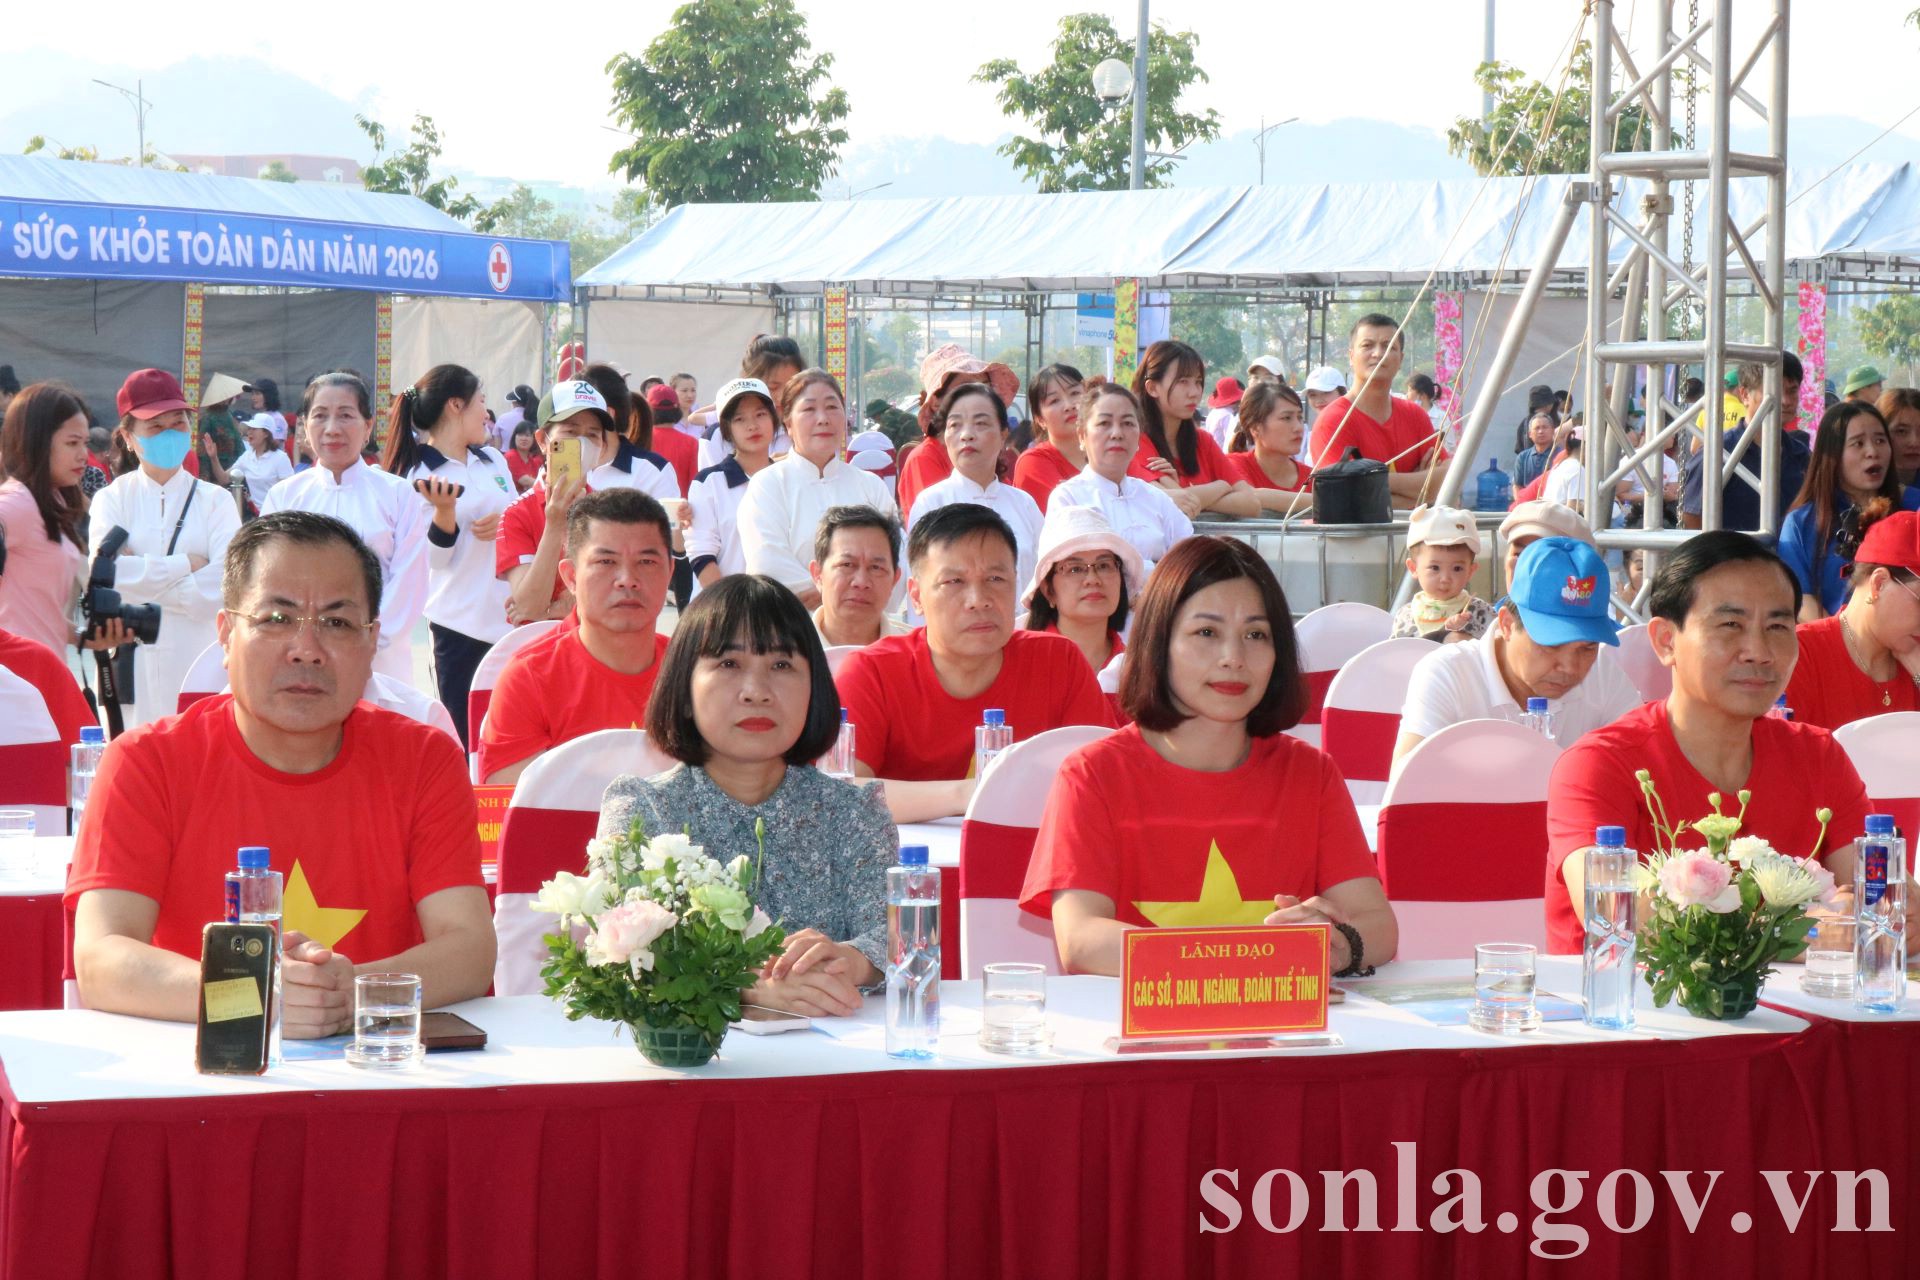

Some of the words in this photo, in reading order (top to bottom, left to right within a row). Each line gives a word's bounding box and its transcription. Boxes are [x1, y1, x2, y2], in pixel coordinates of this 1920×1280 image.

[13, 212, 79, 261] SỨC
[89, 215, 171, 264] KHỎE
[177, 222, 254, 268] TOÀN
[261, 228, 315, 272] DÂN
[323, 234, 378, 276] NĂM
[384, 245, 439, 280] 2026
[1181, 942, 1231, 959] LÃNH
[1236, 943, 1275, 959] ĐẠO
[1134, 976, 1154, 1006] CÁC
[1157, 972, 1174, 1008] SỞ,
[1176, 979, 1200, 1007] BAN,
[1203, 973, 1241, 1005] NGÀNH,
[1244, 972, 1272, 1003] ĐOÀN
[1275, 966, 1295, 1001] THỂ
[1296, 967, 1318, 1000] TỈNH
